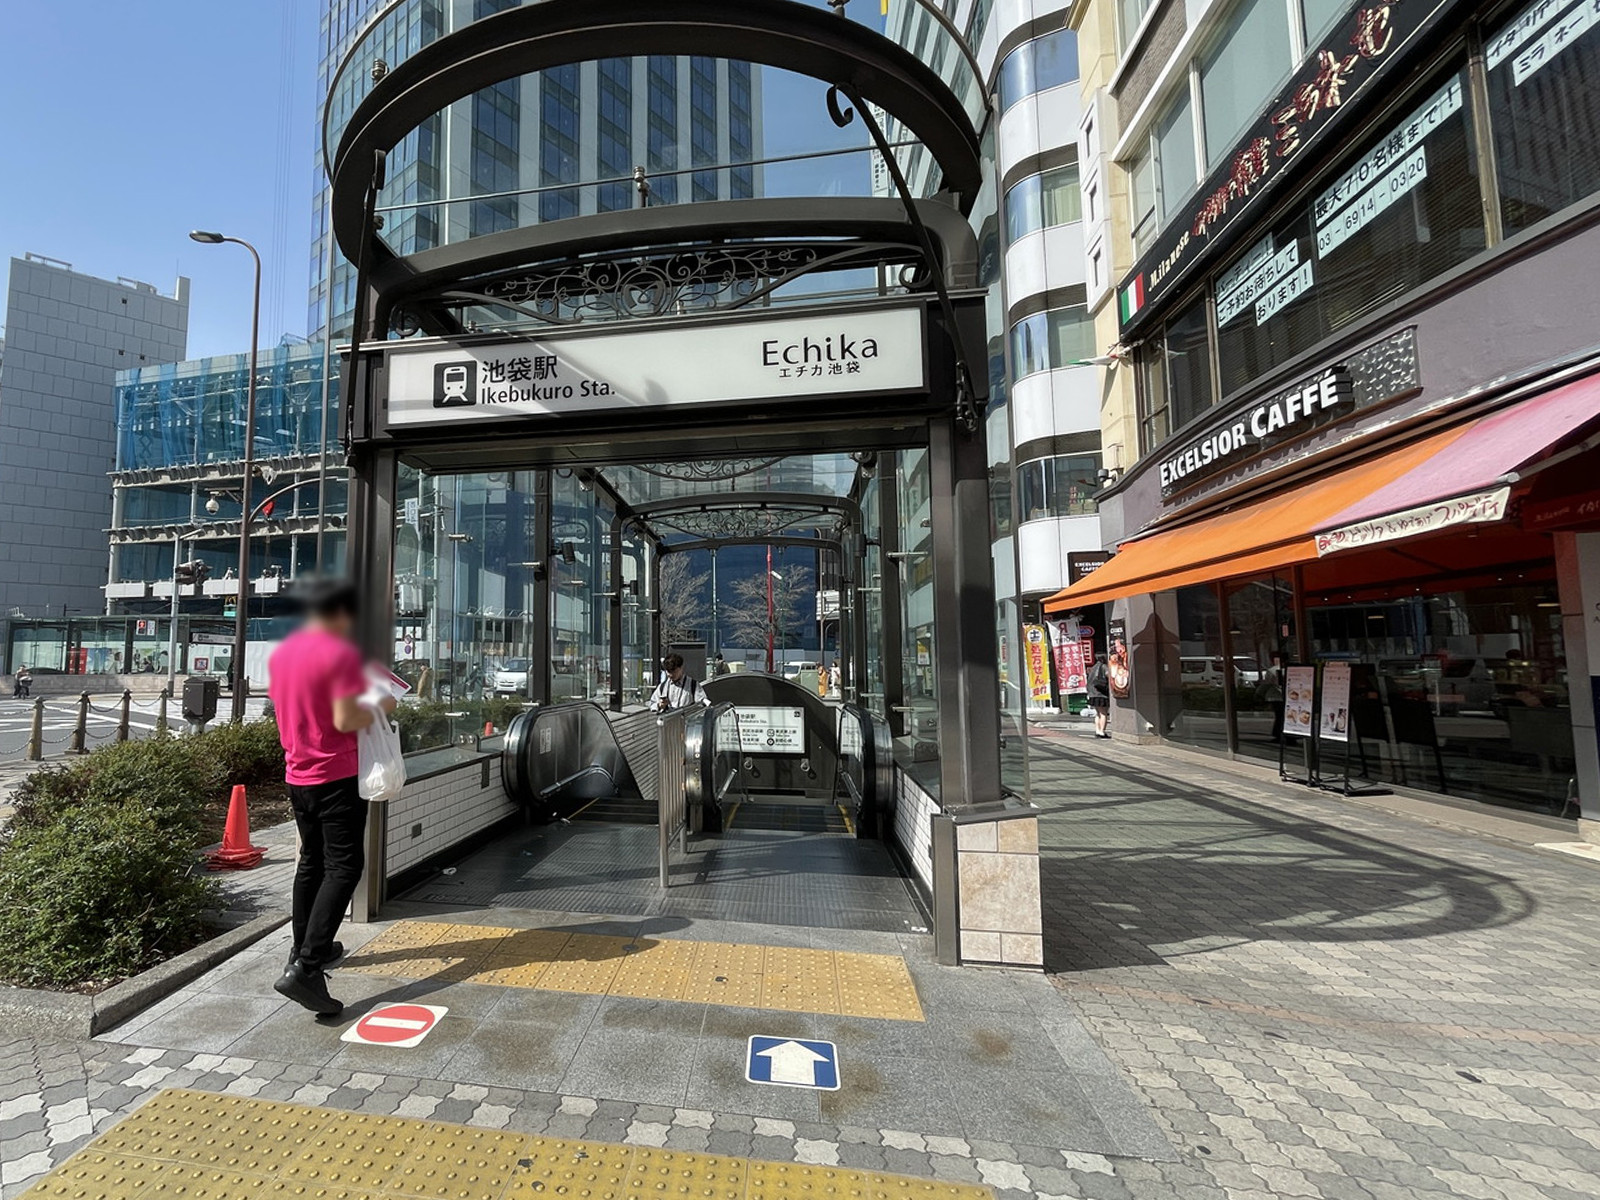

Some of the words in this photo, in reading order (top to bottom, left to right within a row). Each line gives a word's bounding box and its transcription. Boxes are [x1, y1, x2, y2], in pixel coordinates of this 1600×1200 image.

[1218, 245, 1296, 322] ご予約お待ちして
[1257, 268, 1308, 320] おります！
[763, 334, 879, 367] Echika
[482, 355, 558, 382] 池袋駅
[779, 360, 862, 378] エチカ池袋
[482, 381, 573, 405] Ikebukuro
[581, 378, 616, 399] Sta.
[1160, 422, 1246, 489] EXCELSIOR
[1251, 367, 1340, 439] CAFFÉ
